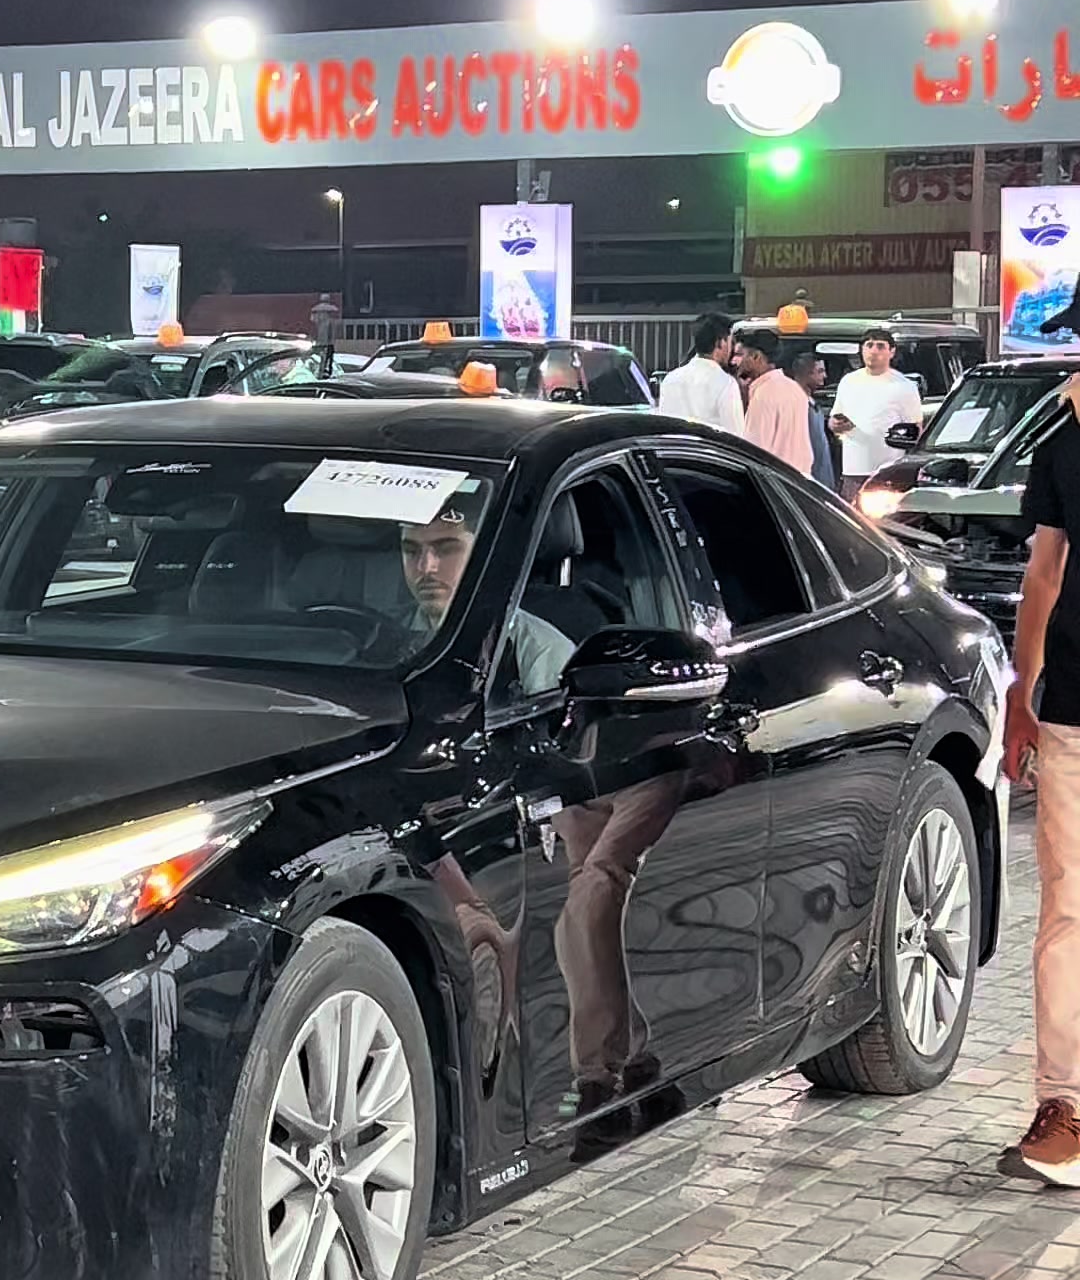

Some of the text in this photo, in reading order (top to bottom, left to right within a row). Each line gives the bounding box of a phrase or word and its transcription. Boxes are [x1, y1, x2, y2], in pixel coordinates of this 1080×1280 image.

[47, 64, 243, 147] JAZEERA
[257, 58, 377, 143] CARS
[391, 43, 641, 138] AUCTIONS
[753, 240, 815, 269] AYESHA
[819, 240, 873, 269] AKTER
[878, 240, 920, 267] JULY
